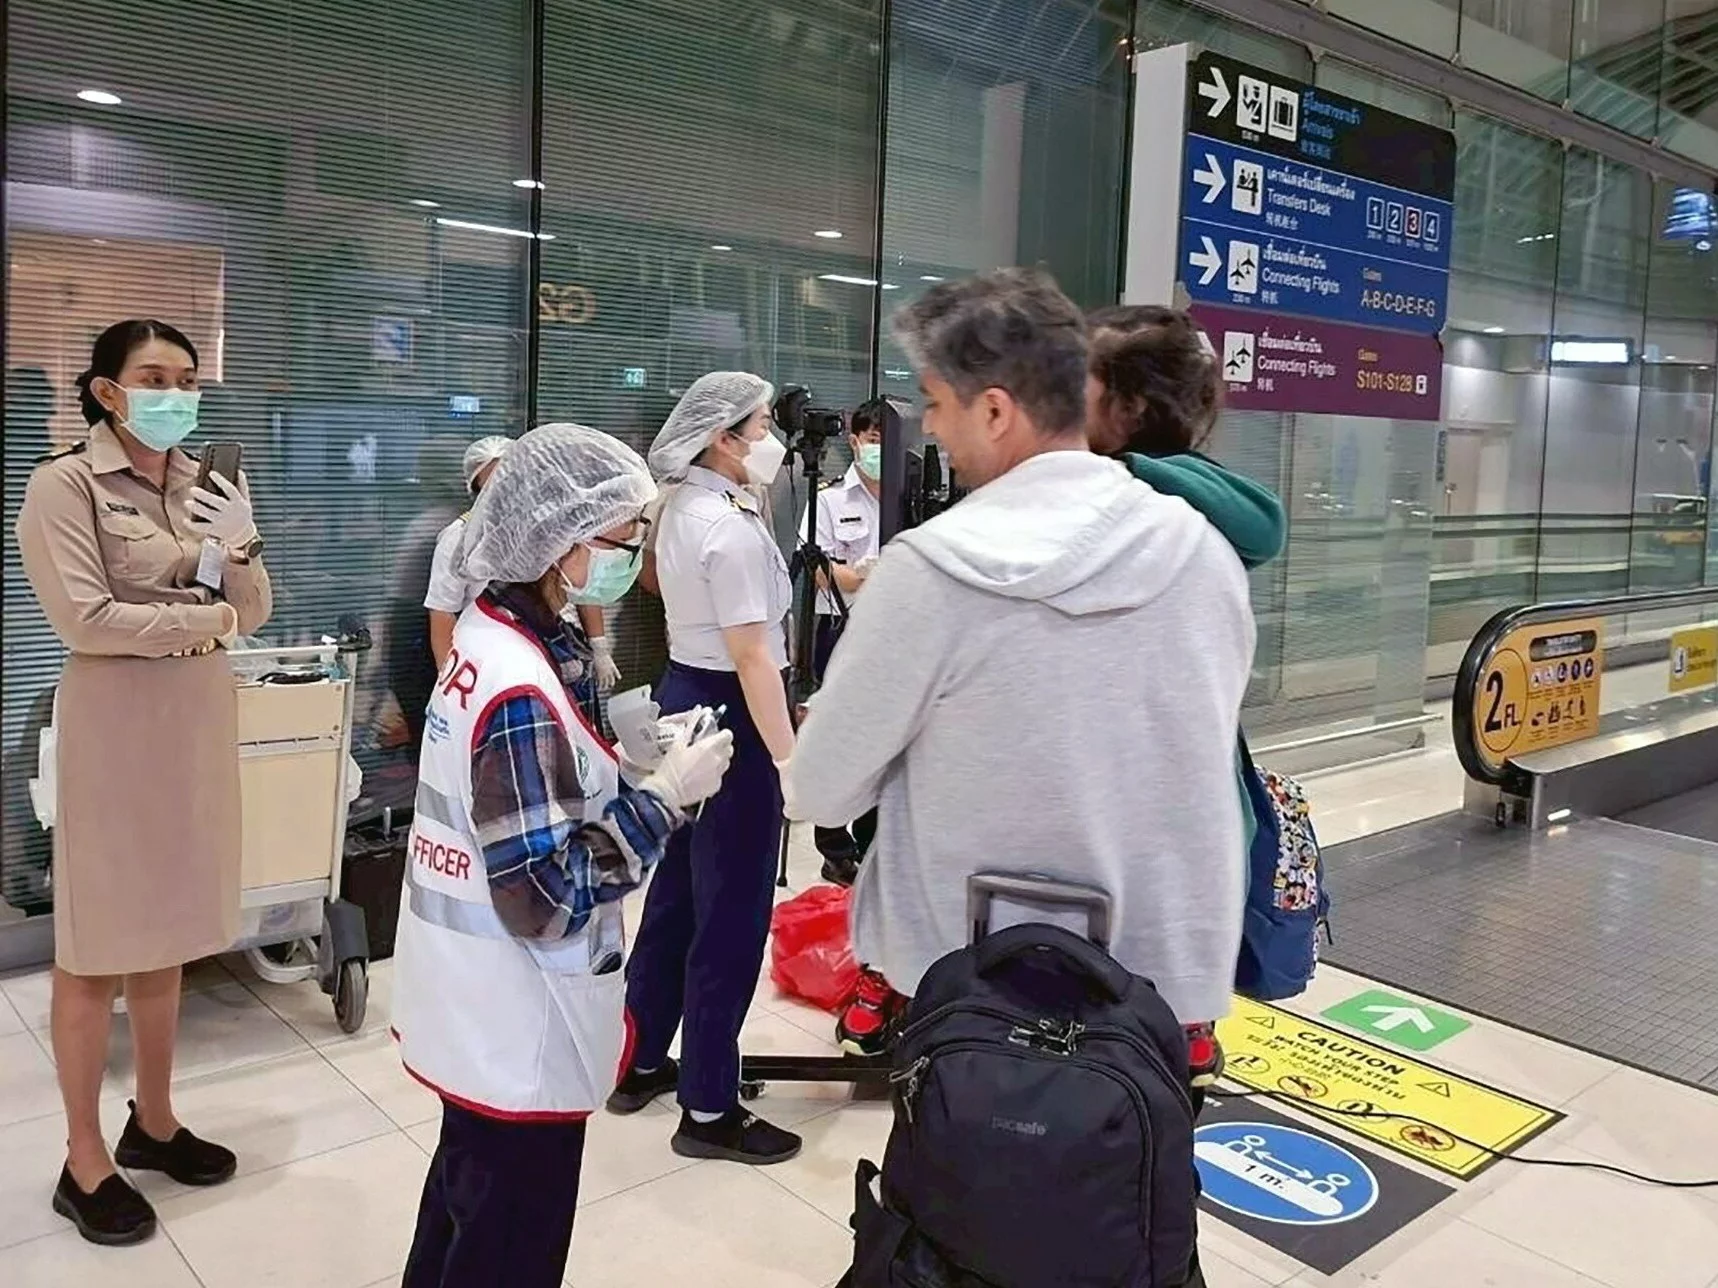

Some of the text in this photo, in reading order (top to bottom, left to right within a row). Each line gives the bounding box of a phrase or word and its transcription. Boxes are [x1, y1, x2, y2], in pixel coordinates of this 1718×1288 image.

[1267, 188, 1331, 216] Transfers Desk
[1372, 205, 1436, 237] 1 2 3 4
[1262, 267, 1340, 295] Connecting Flights
[1361, 289, 1436, 318] A-B-C-D-E-F-G
[1257, 356, 1337, 378] Connecting Flights
[1484, 670, 1504, 733] 2
[413, 834, 471, 880] FFICER
[1274, 1035, 1400, 1085] WATCH YOUR STEP
[1297, 1031, 1407, 1076] CAUTION
[1244, 1163, 1257, 1173] 1
